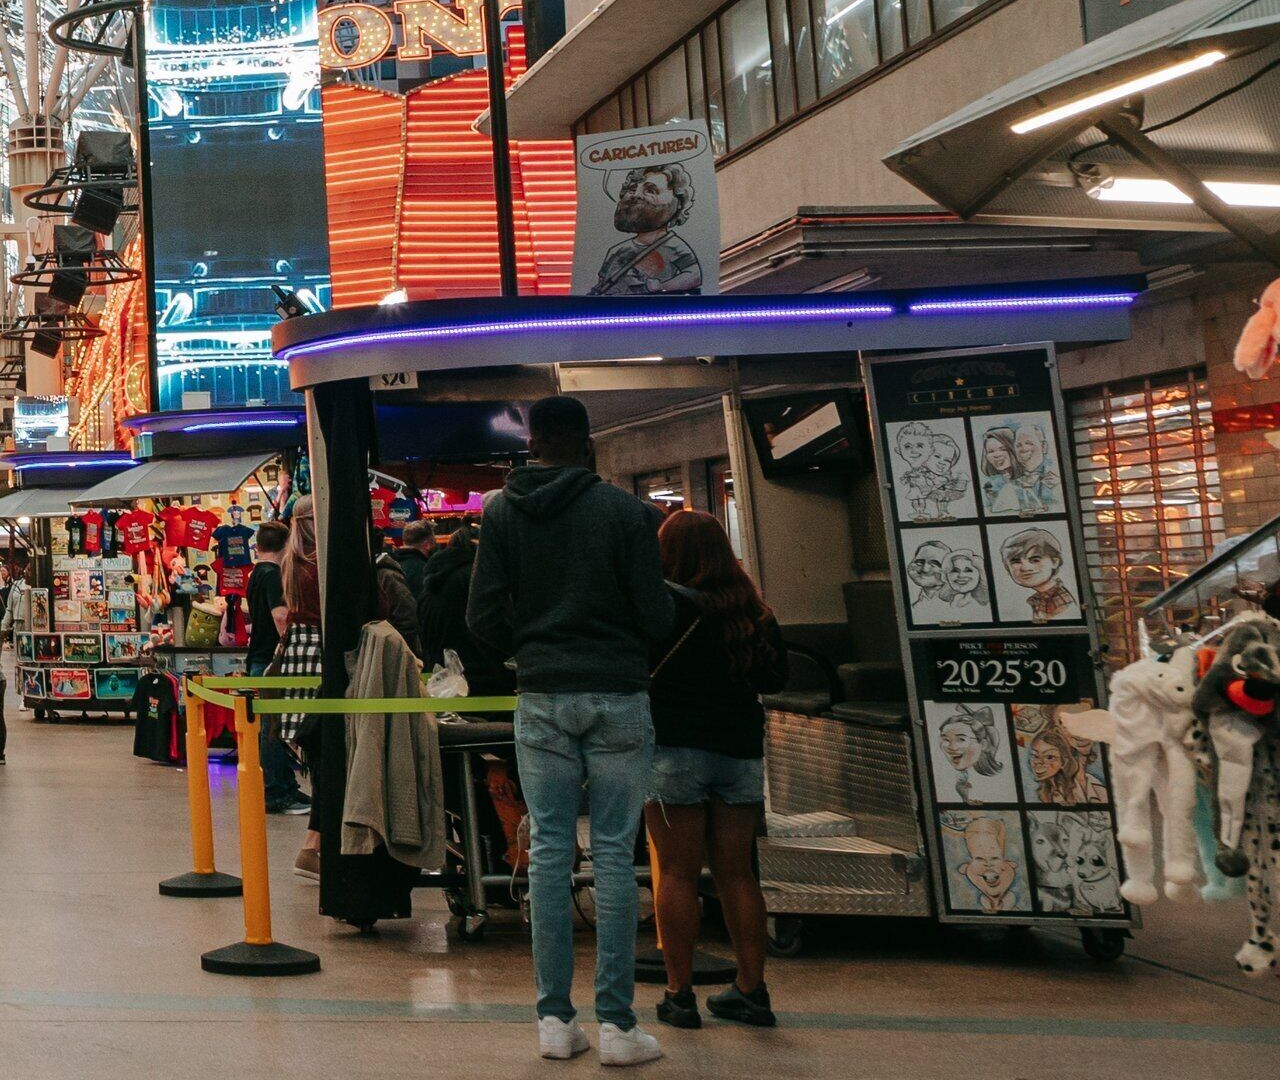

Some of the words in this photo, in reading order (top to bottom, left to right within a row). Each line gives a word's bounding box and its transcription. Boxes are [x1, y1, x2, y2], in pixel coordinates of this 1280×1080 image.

[588, 133, 699, 165] CARICATURES!
[1003, 641, 1037, 650] PERSON
[937, 660, 980, 687] $20
[980, 659, 1021, 687] $25
[1024, 660, 1067, 687] $30
